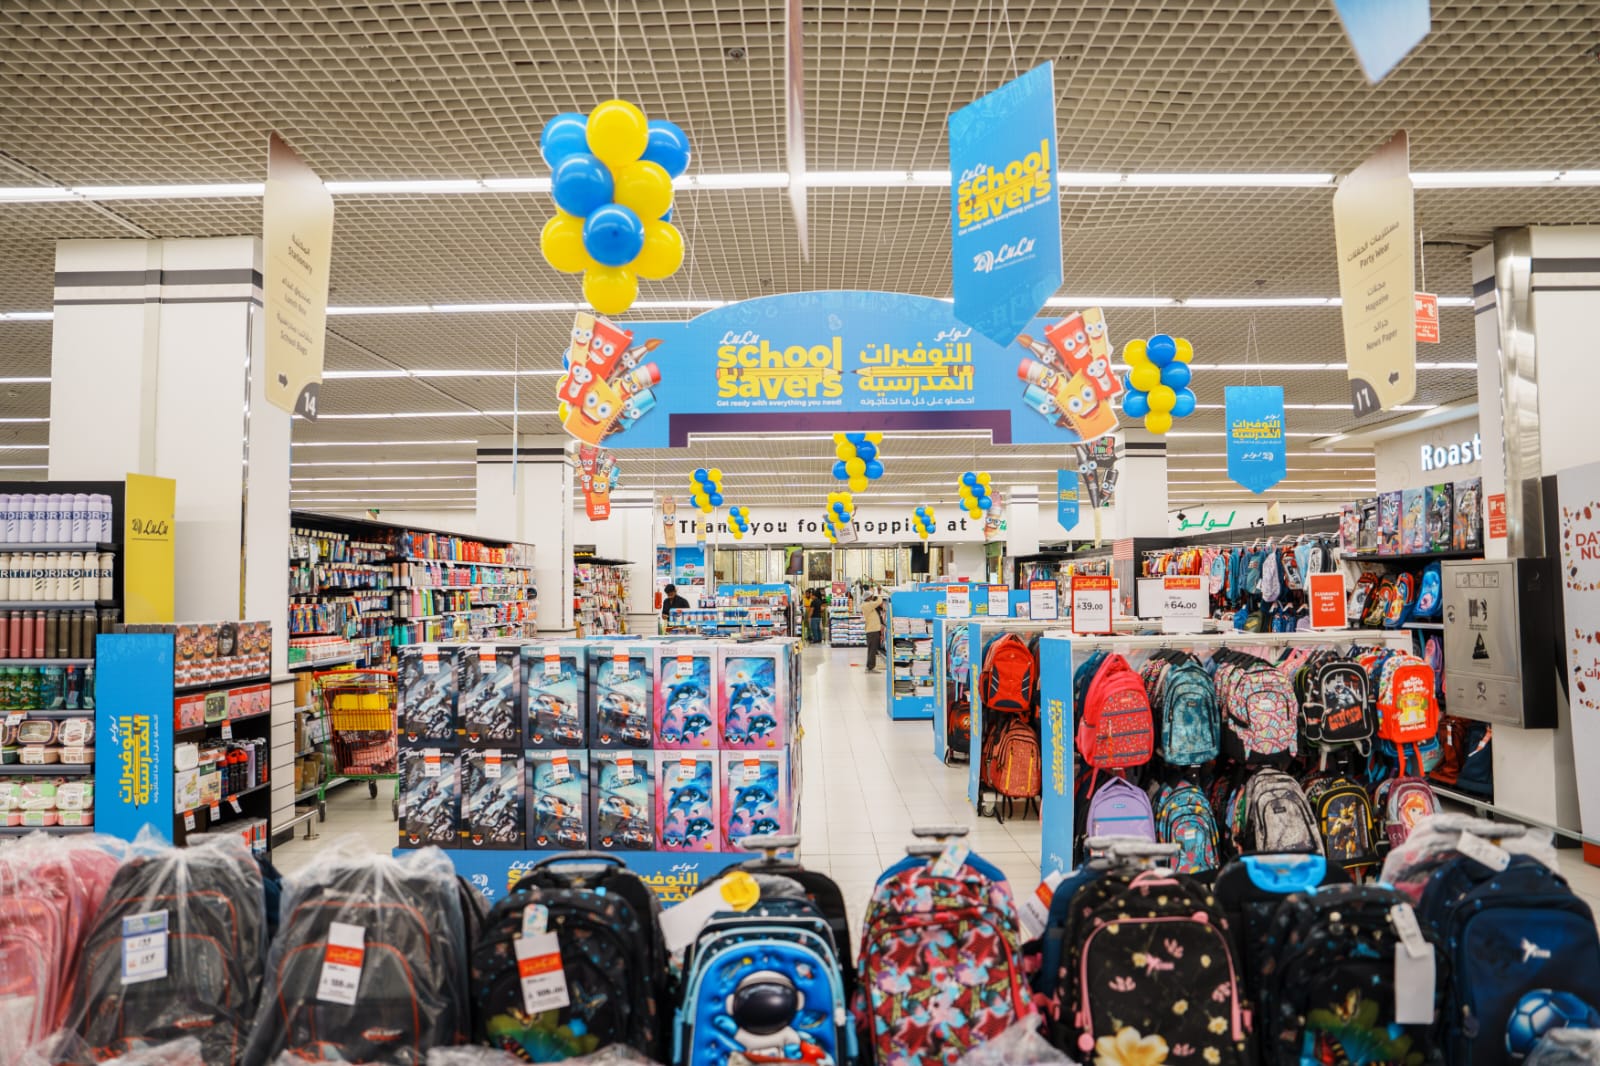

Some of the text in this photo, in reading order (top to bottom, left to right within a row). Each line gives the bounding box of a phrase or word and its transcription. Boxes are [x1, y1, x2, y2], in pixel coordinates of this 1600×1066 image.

[958, 138, 1050, 202] school
[958, 171, 1051, 228] savers
[717, 336, 842, 371] school
[860, 342, 972, 368] التوفيرات
[717, 371, 843, 400] savers
[858, 372, 973, 397] المدرسية
[304, 392, 316, 416] 14
[769, 400, 806, 408] everything
[144, 520, 168, 535] LuLu
[679, 520, 729, 534] Than
[751, 521, 787, 535] you
[948, 518, 967, 532] at
[1178, 510, 1236, 531] لولو
[1082, 602, 1104, 610] 39.00
[1170, 601, 1198, 610] 64.00
[118, 716, 135, 804] التوفيرات
